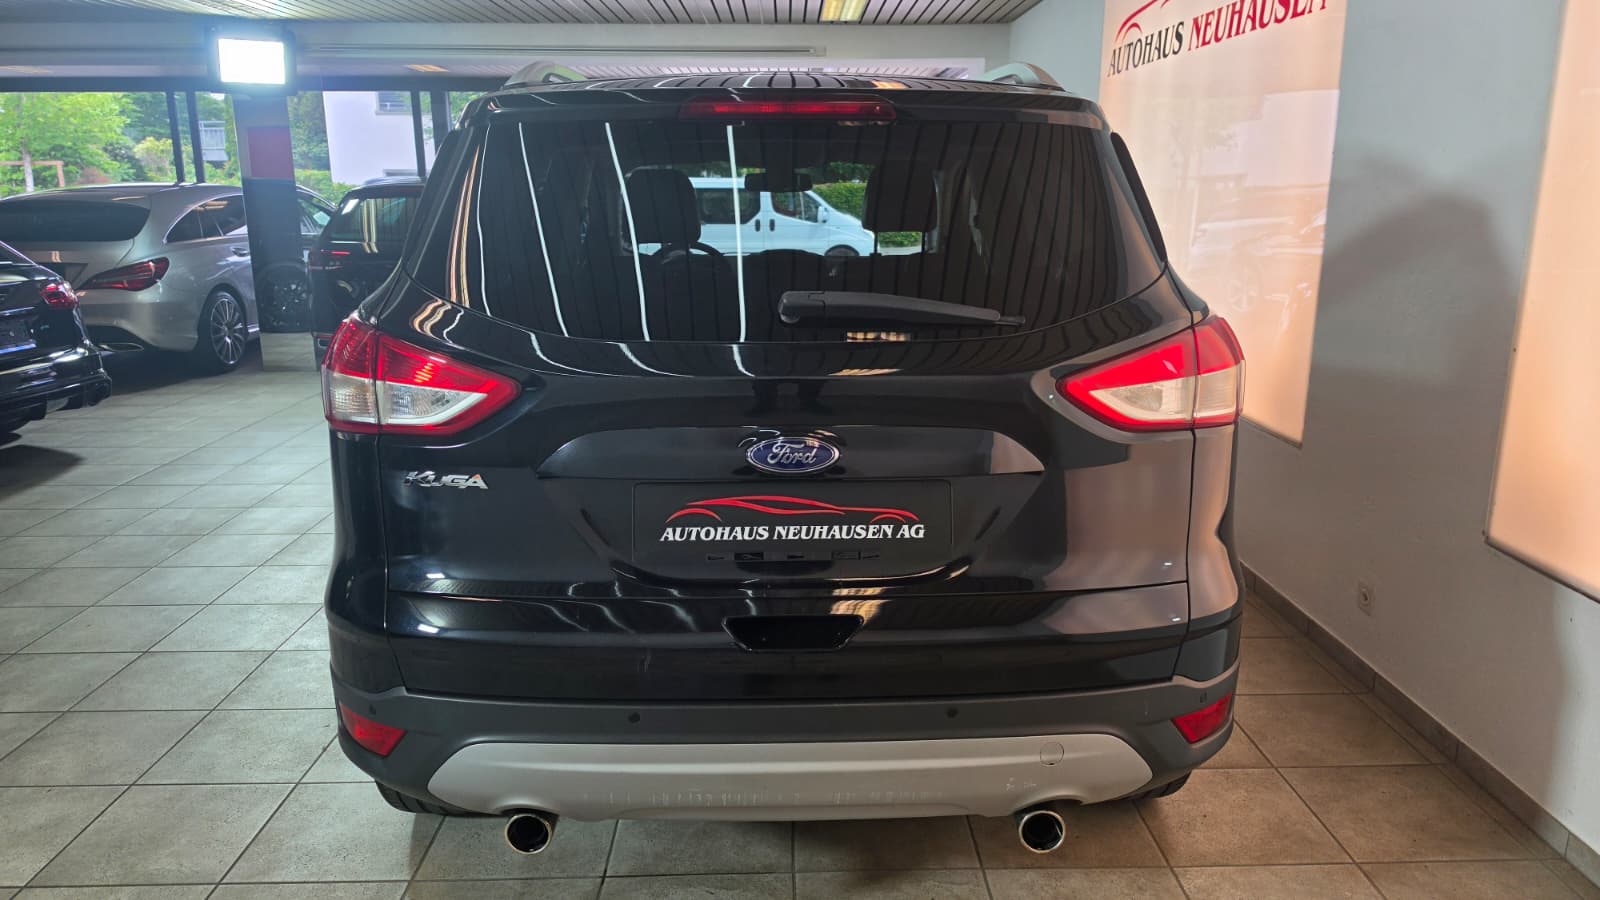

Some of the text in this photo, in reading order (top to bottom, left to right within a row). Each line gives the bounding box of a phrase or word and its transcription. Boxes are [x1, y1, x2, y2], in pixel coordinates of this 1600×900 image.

[1107, 20, 1184, 77] AUTOHAUS
[767, 441, 817, 464] Ford
[404, 470, 489, 490] KUGA
[660, 524, 926, 541] AUTOHAUS NEUHAUSEN AG
